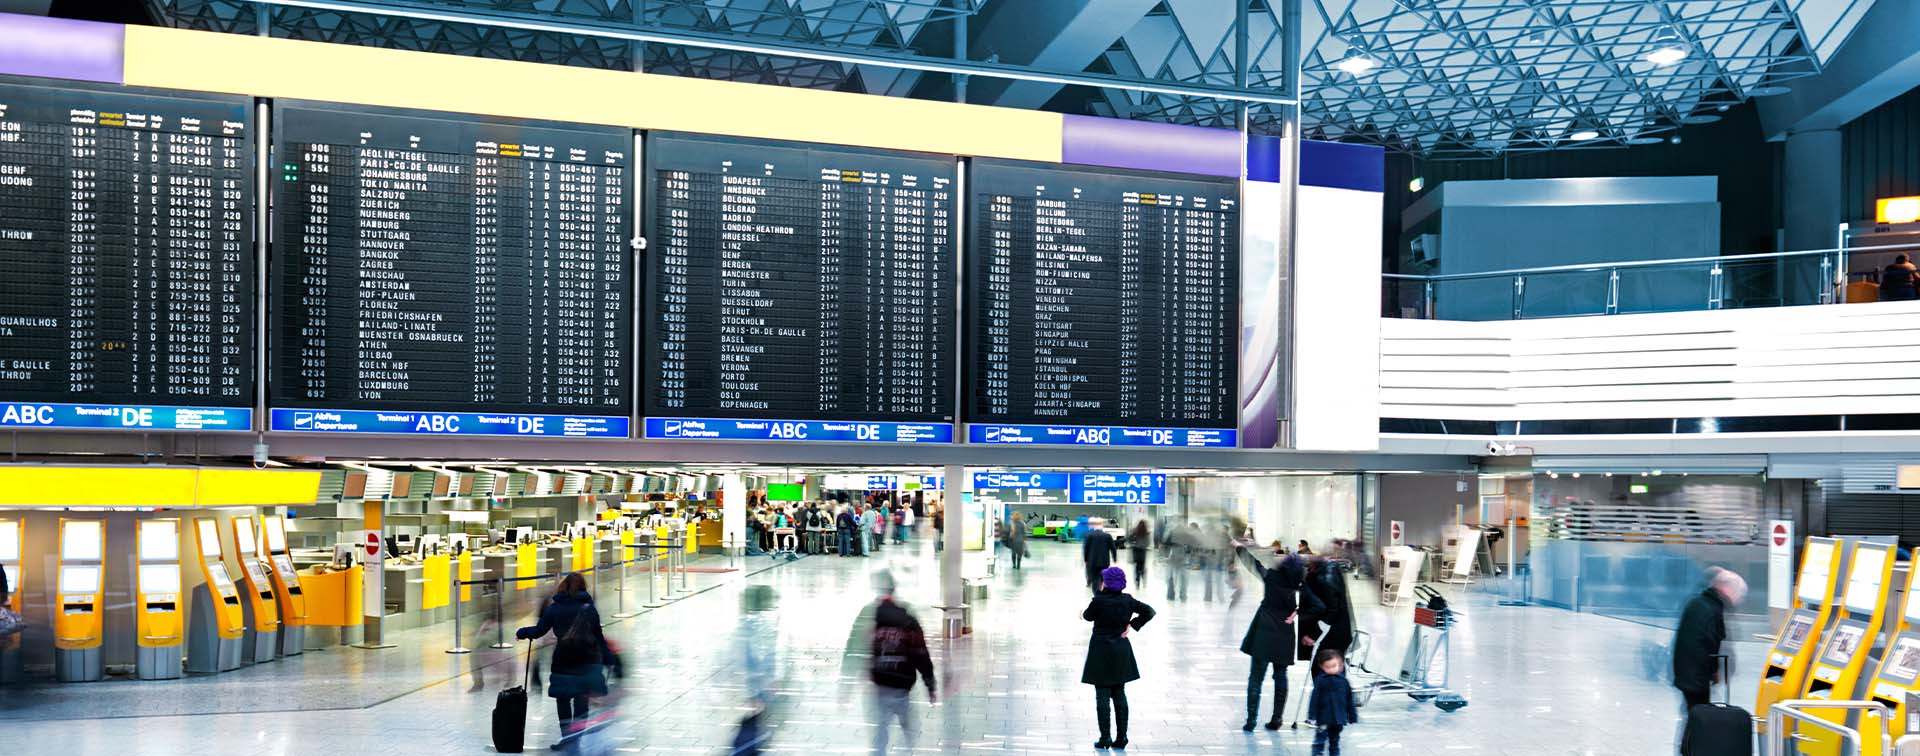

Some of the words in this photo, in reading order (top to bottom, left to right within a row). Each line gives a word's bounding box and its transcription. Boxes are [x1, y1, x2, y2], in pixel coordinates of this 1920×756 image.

[428, 164, 459, 173] GAULLE
[361, 169, 427, 181] JOHANNESBURG
[361, 179, 388, 188] TOKIO
[394, 182, 427, 190] NARITA
[723, 176, 760, 185] BUDAPEST
[724, 186, 766, 195] INNSBRUCK
[723, 195, 756, 204] BOLOGNA
[360, 200, 399, 209] ZUERICH
[723, 204, 756, 213] BELGRAD
[360, 210, 410, 220] NUERNBERG
[723, 214, 751, 222] MADRID
[360, 220, 399, 229] HAMBURG
[723, 224, 793, 234] LONDON-HEATHROW
[360, 240, 404, 249] HANNOVER
[723, 242, 741, 250] LINZ
[360, 250, 398, 259] BANGKOK
[360, 260, 393, 269] ZAGREB
[360, 271, 404, 280] WARSCHAU
[722, 270, 769, 279] MANCHESTER
[360, 281, 409, 290] AMSTERDAM
[360, 291, 414, 300] HOF-PLAUEN
[722, 289, 760, 297] LISSABON
[360, 300, 398, 309] FLORENZ
[360, 311, 442, 321] FRIEDRICHSHAFEN
[722, 317, 764, 325] STOCKHOLM
[360, 321, 435, 331] MAILAND-LINATE
[360, 331, 402, 339] MUENSTER
[409, 333, 462, 342] OSNABRUECK
[779, 328, 805, 336] GAULLE
[722, 345, 763, 353] STAVANGER
[359, 351, 392, 359] BILBAO
[722, 354, 749, 362] BREMEN
[359, 371, 408, 379] BARCELONA
[722, 382, 758, 390] TOULOUSE
[2, 406, 53, 423] ABC
[75, 407, 110, 415] Terminal
[122, 408, 152, 426] DE
[314, 422, 357, 430] Departures
[377, 414, 409, 422] Terminal
[416, 415, 459, 432] ABC
[518, 417, 544, 433] DE
[770, 423, 808, 439] ABC
[857, 424, 879, 440] DE
[1153, 430, 1172, 444] DE
[1030, 474, 1040, 487] C
[1126, 475, 1150, 488] A,B
[1126, 490, 1150, 503] D,E
